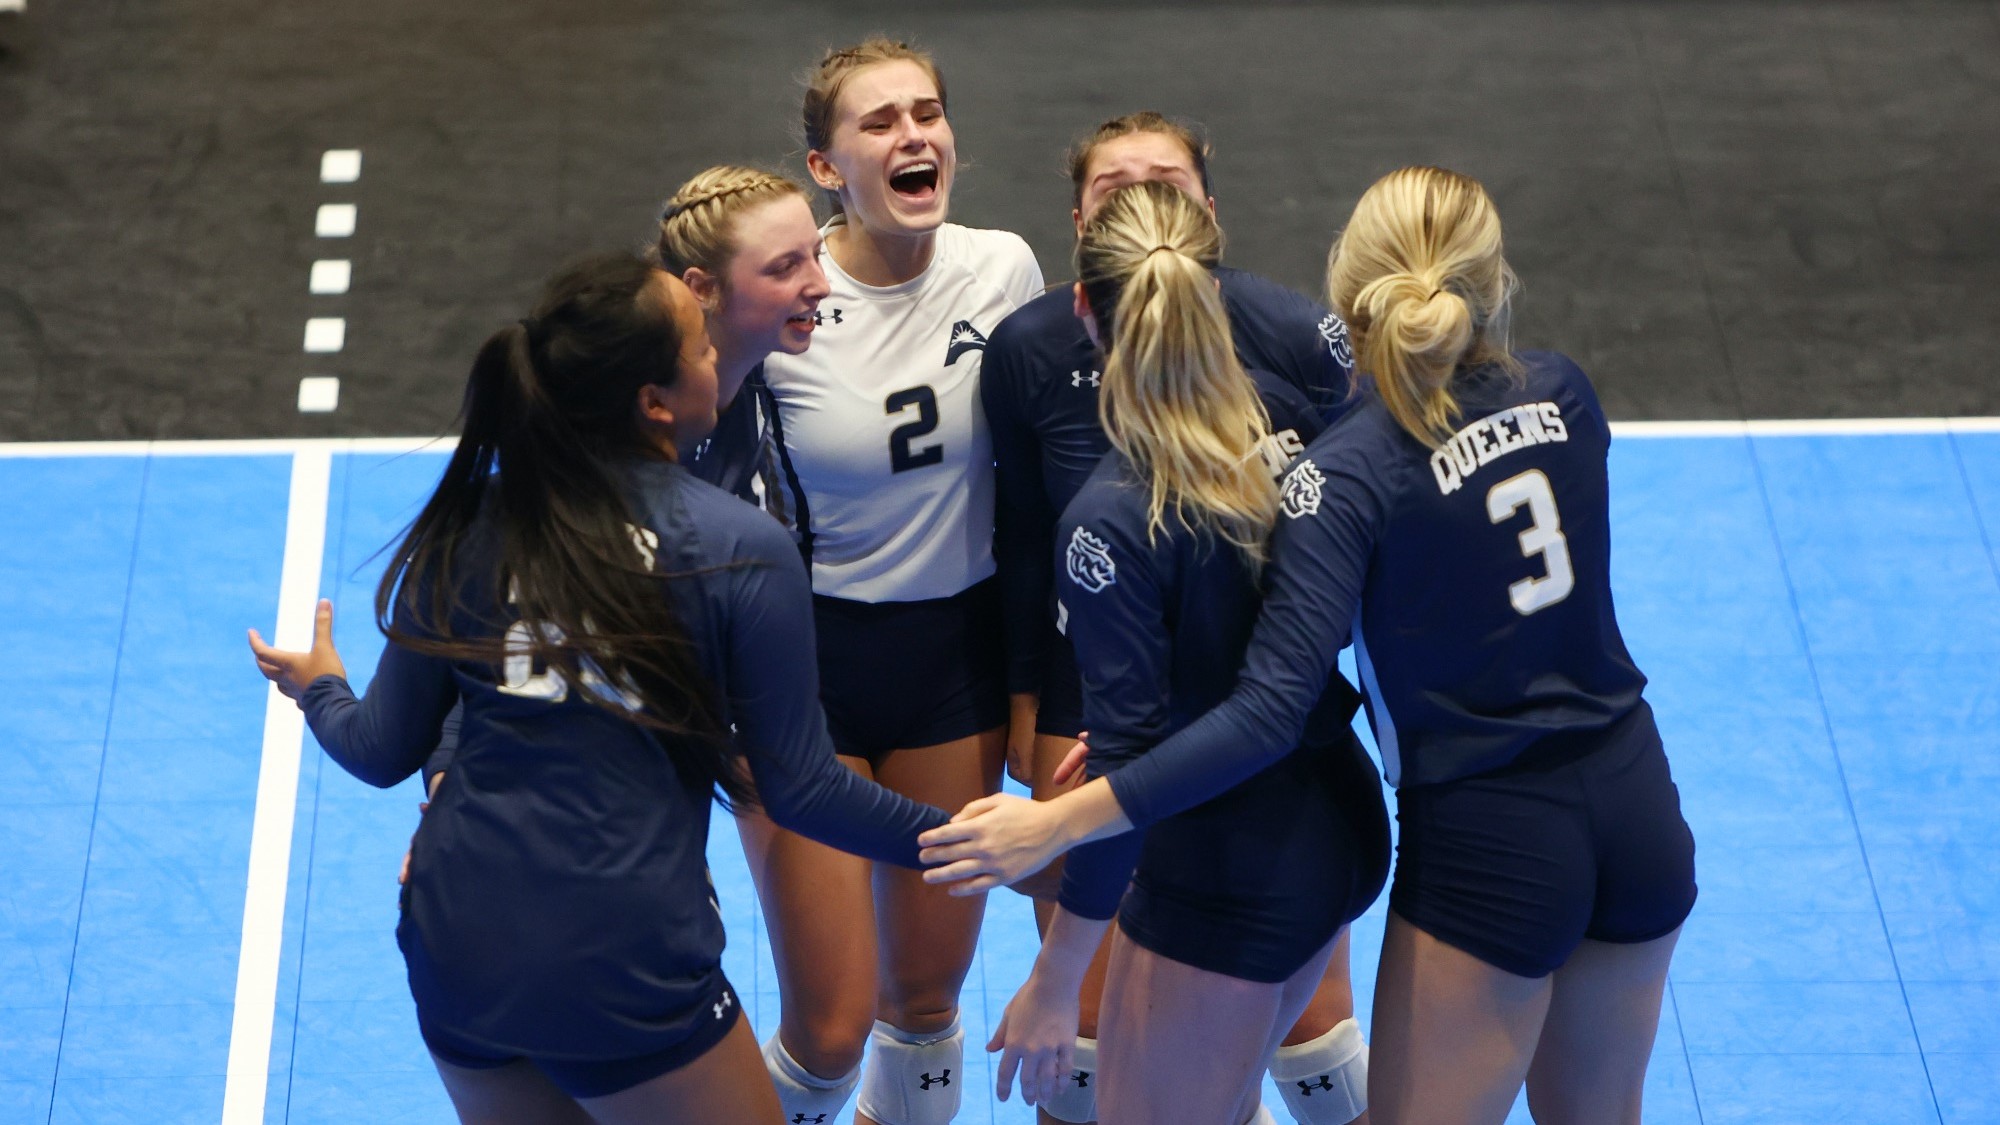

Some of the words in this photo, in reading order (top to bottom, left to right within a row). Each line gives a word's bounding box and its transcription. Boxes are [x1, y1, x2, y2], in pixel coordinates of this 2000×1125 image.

[884, 384, 943, 474] 2
[1430, 402, 1568, 495] QUEENS
[1486, 468, 1575, 615] 3
